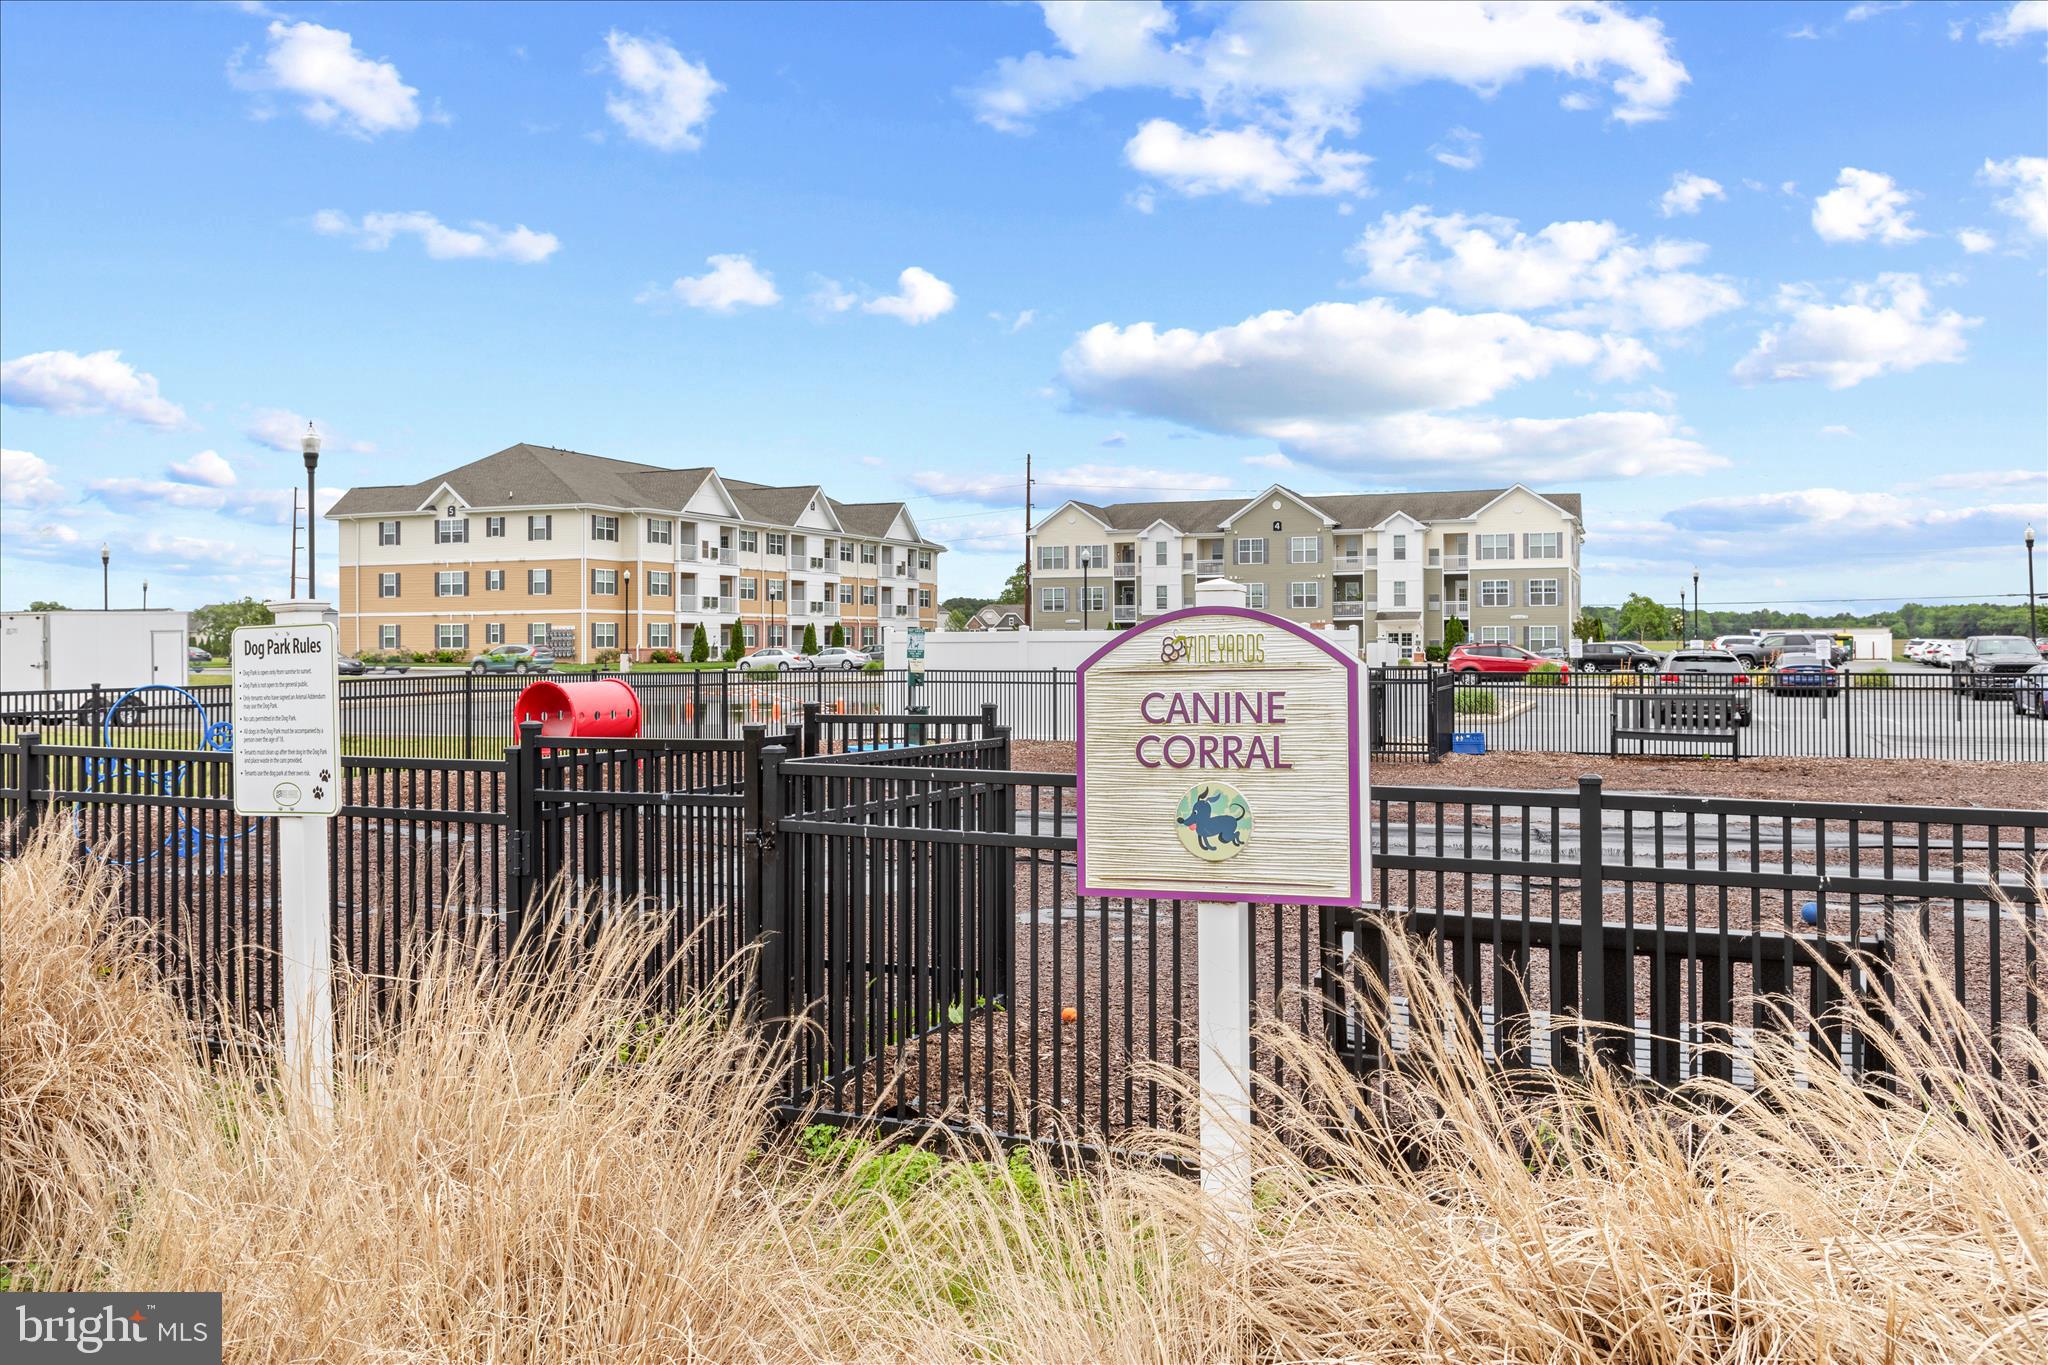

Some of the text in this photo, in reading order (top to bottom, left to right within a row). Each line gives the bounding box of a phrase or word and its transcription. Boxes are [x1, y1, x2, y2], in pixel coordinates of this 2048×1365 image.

[244, 637, 321, 659] Dog Park Rules
[1184, 633, 1264, 663] VINEYARDS
[1140, 691, 1286, 724] CANINE
[1136, 735, 1293, 769] CORRAL
